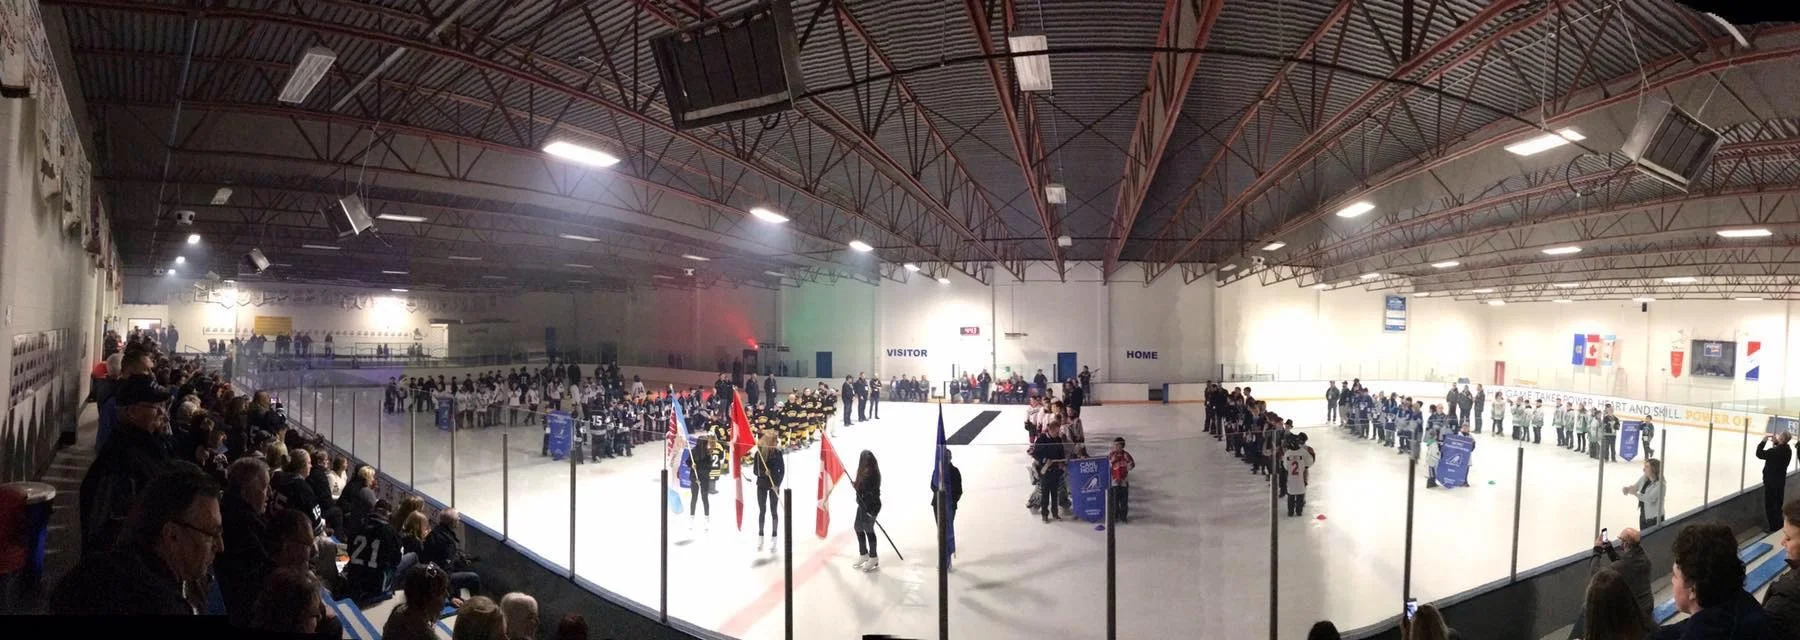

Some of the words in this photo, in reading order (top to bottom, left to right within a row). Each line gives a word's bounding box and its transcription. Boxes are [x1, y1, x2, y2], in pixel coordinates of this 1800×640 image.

[886, 348, 928, 357] VISITOR
[1126, 350, 1158, 359] HOME
[1629, 404, 1650, 416] AND
[591, 415, 603, 426] 15
[712, 454, 719, 467] 2
[1291, 461, 1299, 476] 2
[350, 534, 382, 568] 21
